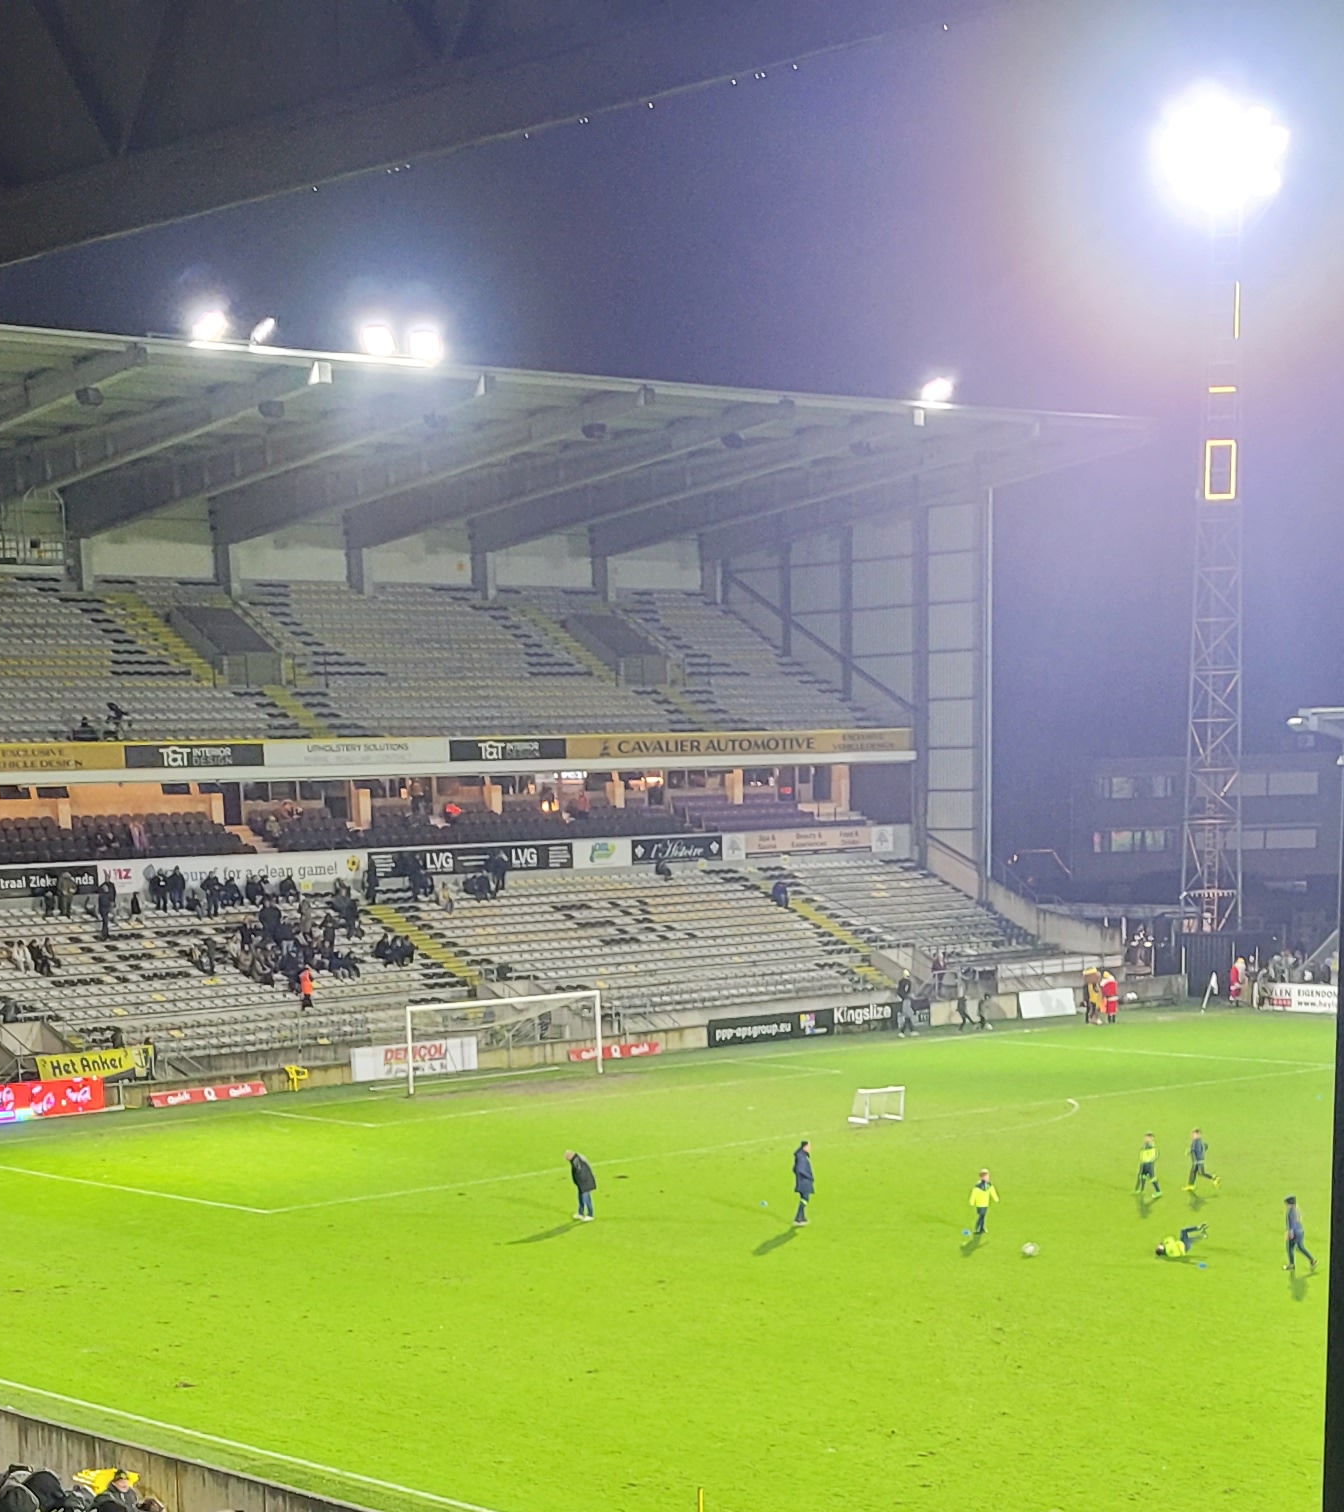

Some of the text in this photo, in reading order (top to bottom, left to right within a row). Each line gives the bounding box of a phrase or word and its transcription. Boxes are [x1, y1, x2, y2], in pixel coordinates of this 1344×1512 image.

[192, 747, 232, 757] INTERIOR
[364, 742, 409, 752] SOLUTIONS
[478, 742, 506, 760] T&T
[618, 737, 815, 754] CAVALIER AUTOMOTIVE
[40, 758, 83, 768] DESIGN
[158, 746, 192, 768] T&T
[193, 757, 233, 766] DESIGN
[425, 852, 453, 870] LVG
[511, 847, 538, 865] LVG
[257, 863, 296, 879] clean
[297, 861, 337, 880] game!
[50, 1053, 124, 1077] Het Anker
